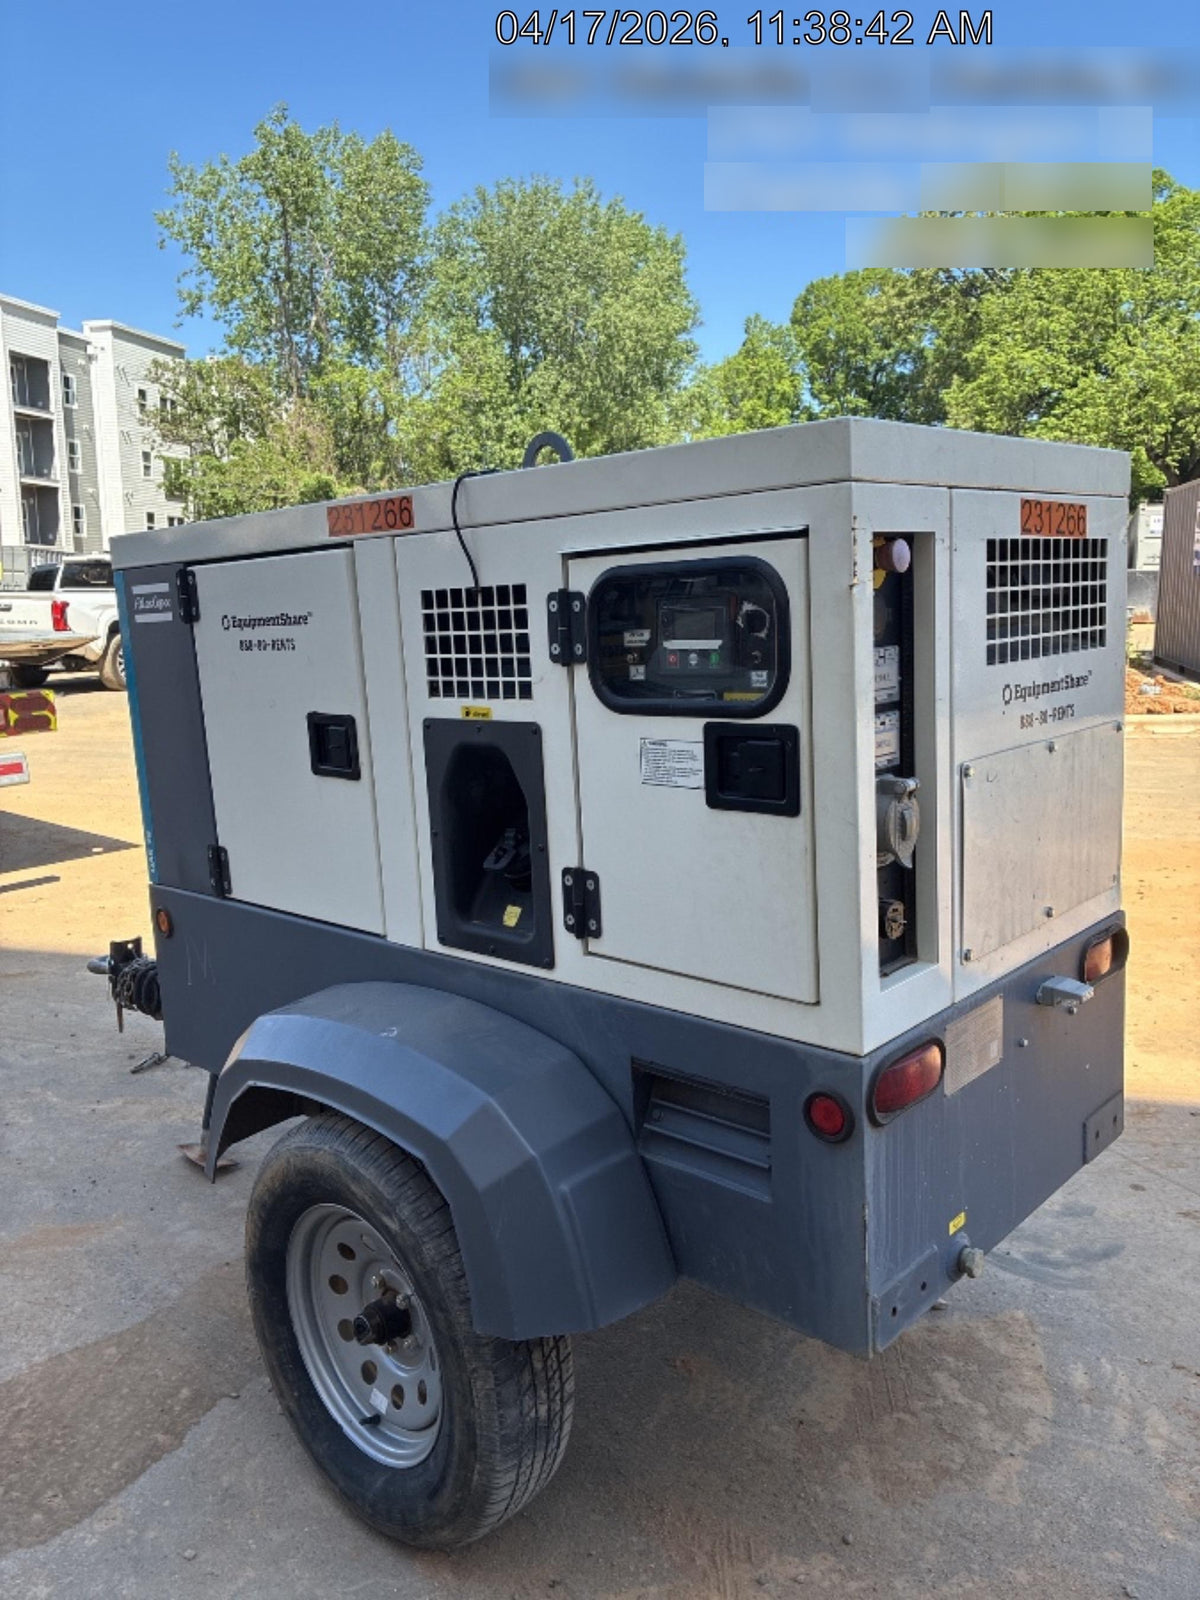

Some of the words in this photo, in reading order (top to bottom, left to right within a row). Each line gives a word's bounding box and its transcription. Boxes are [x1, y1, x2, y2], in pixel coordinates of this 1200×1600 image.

[328, 496, 412, 535] 231266
[1021, 499, 1087, 536] 231266
[231, 612, 308, 631] EquipmentShare
[1014, 674, 1089, 702] EquipmentShare
